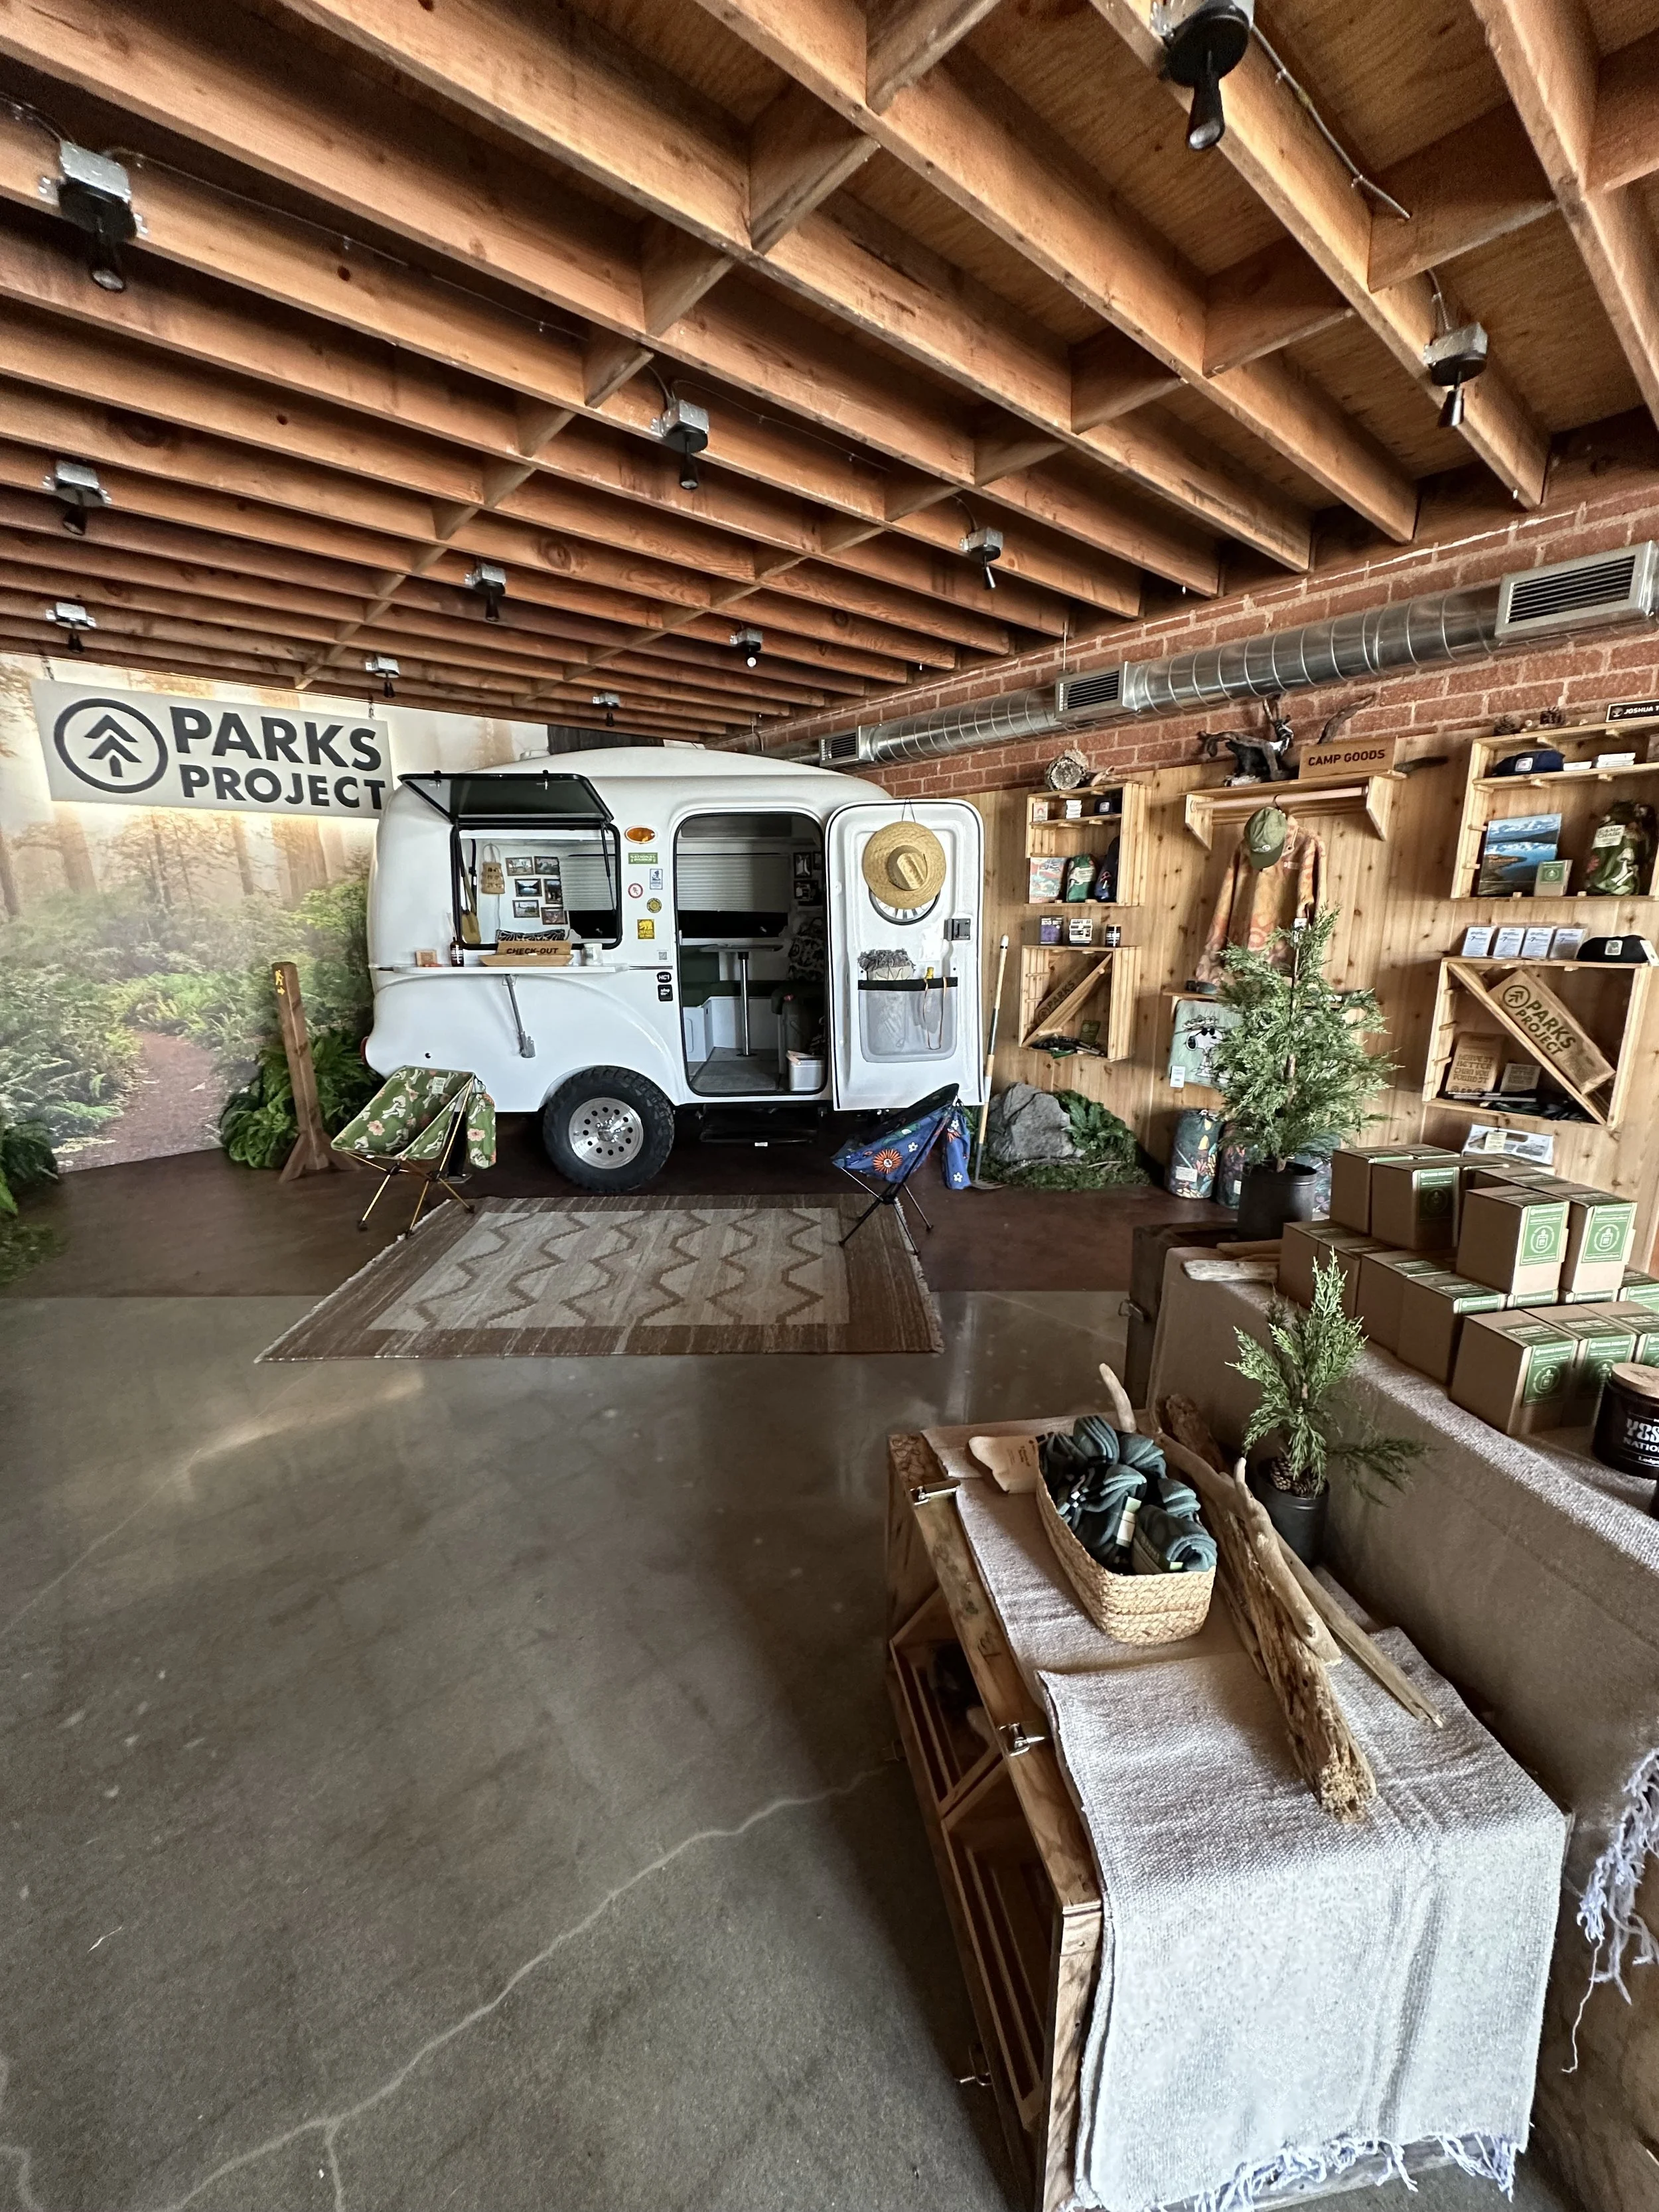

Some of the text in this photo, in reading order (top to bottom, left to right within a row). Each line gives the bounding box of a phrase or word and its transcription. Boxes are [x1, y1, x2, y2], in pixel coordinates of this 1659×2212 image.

[1624, 706, 1653, 715] JOSHUA
[170, 706, 382, 772] PARKS
[1308, 749, 1386, 767] CAMP GOODS
[179, 764, 386, 810] PROJECT
[1047, 980, 1075, 1009] PARKS
[1516, 1009, 1563, 1055] PROJECT
[1526, 999, 1576, 1049] PARKS
